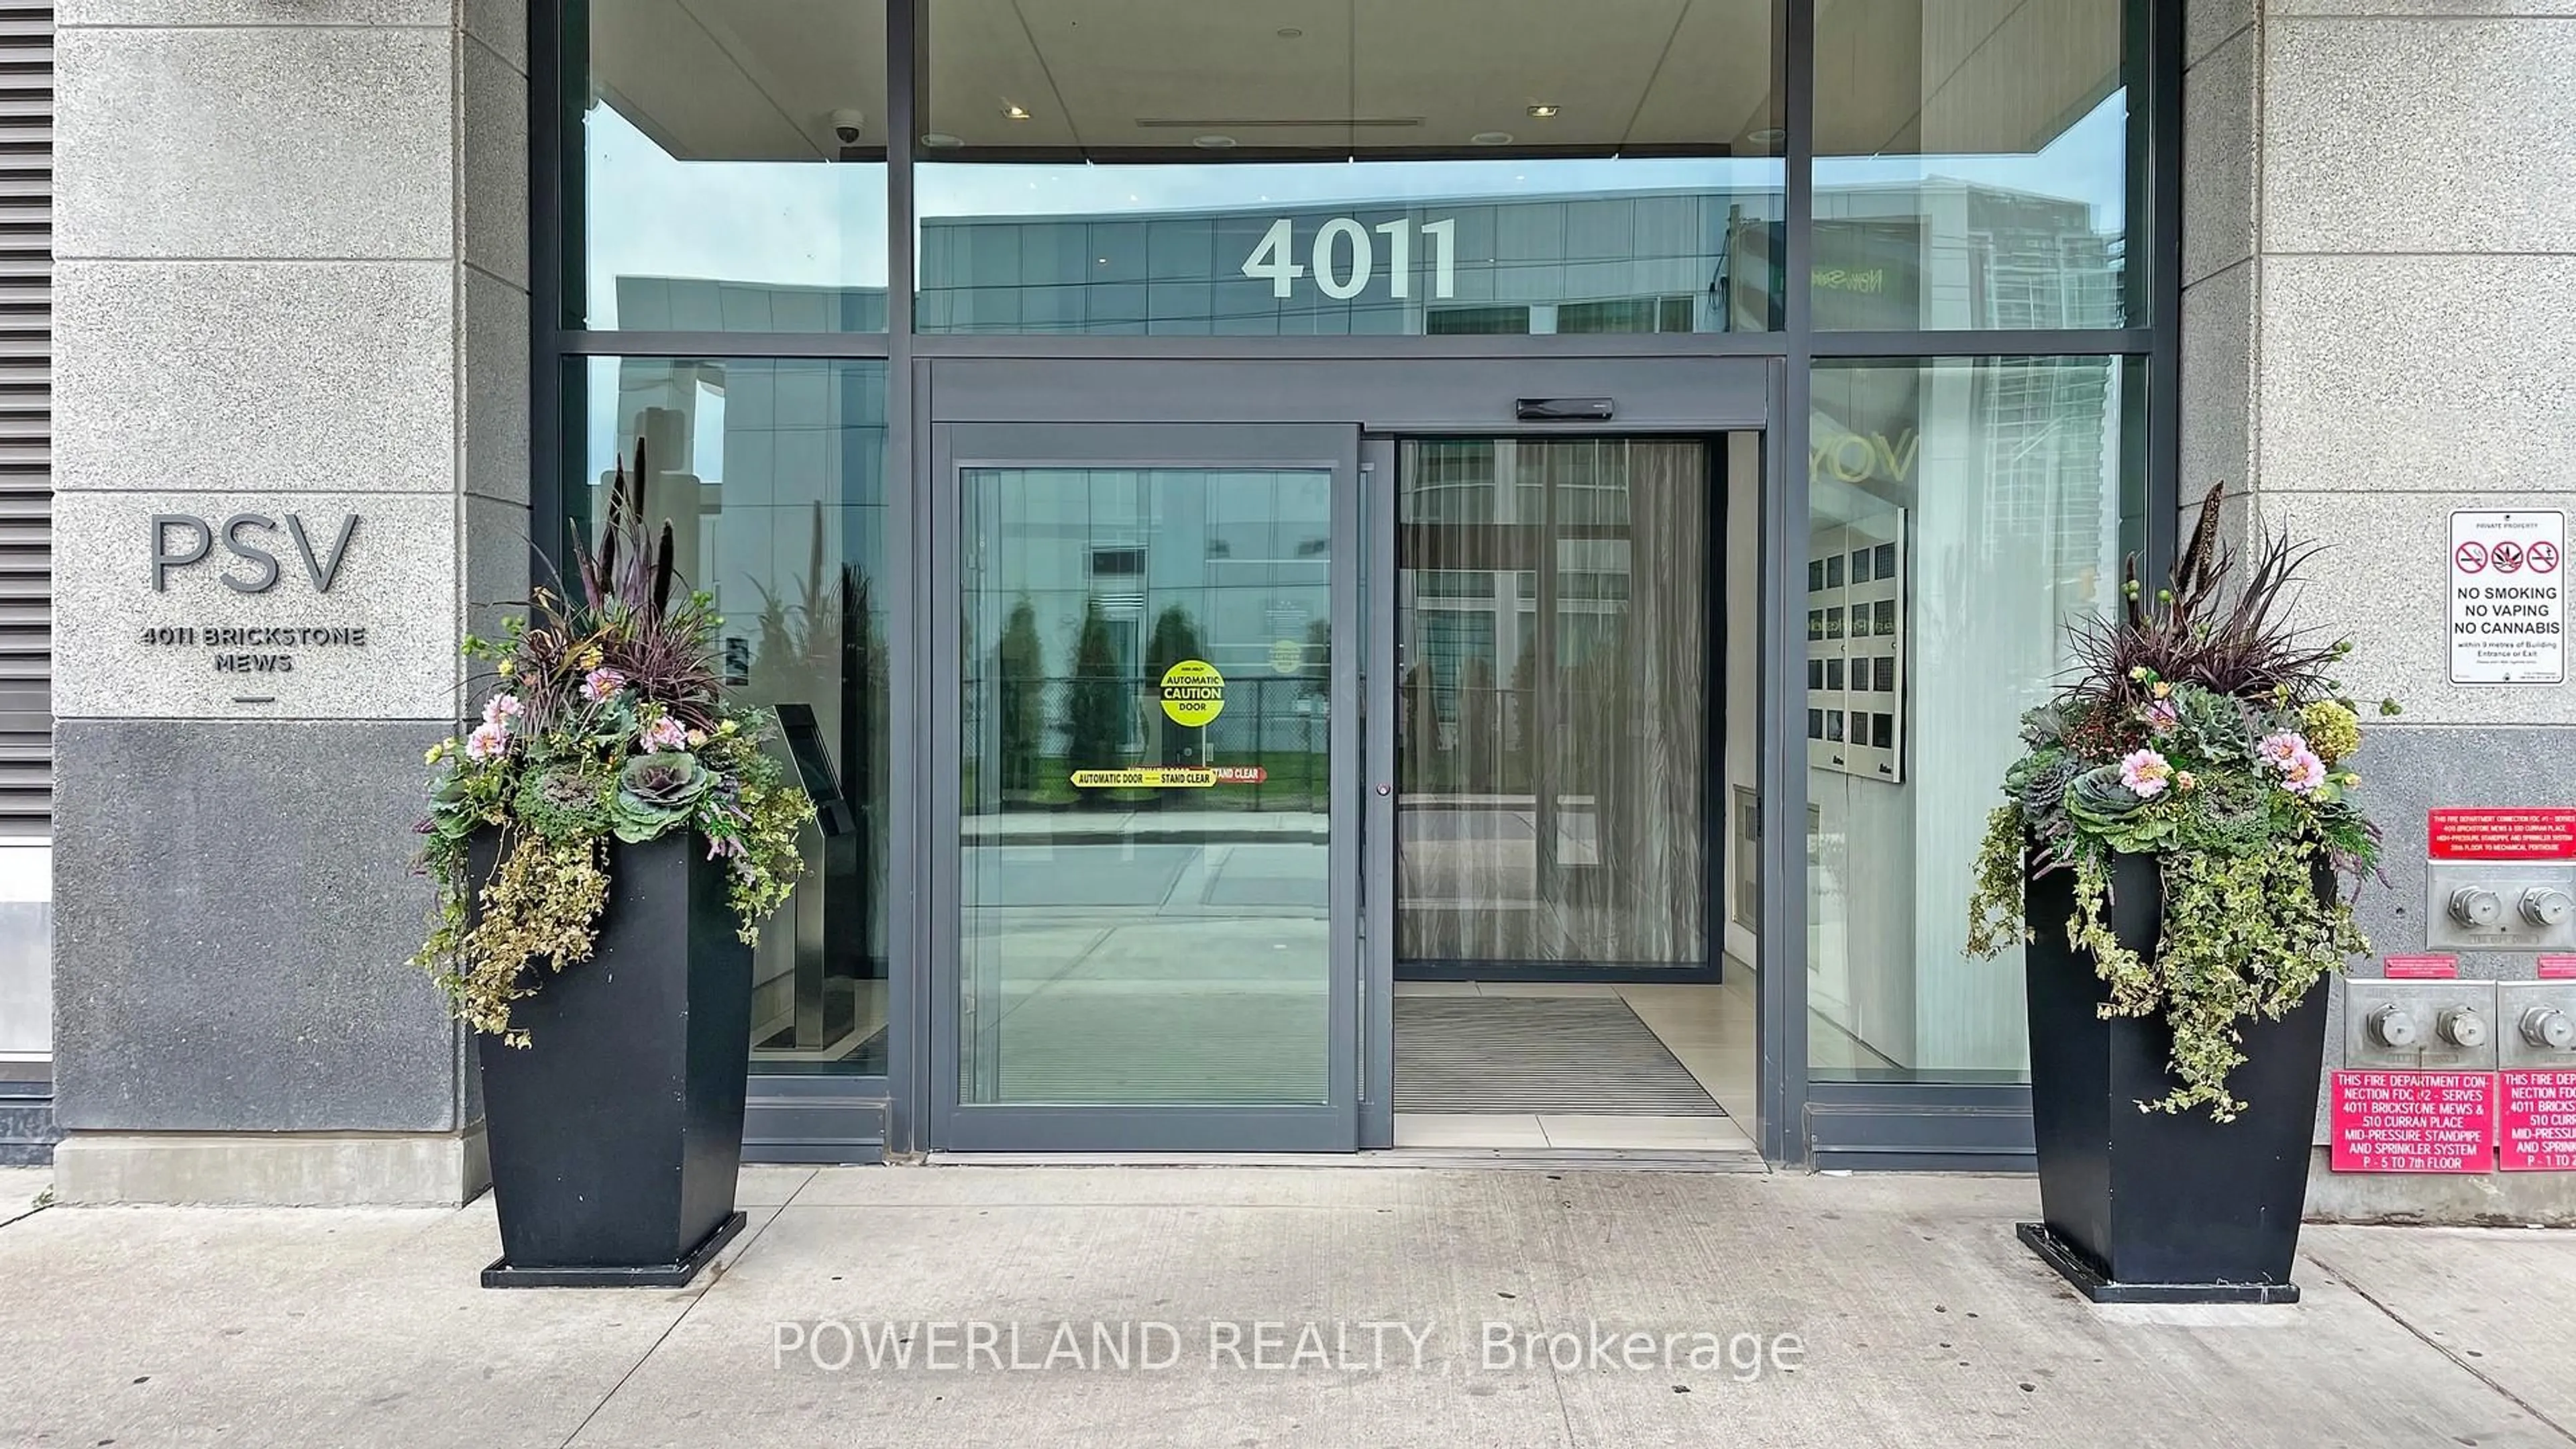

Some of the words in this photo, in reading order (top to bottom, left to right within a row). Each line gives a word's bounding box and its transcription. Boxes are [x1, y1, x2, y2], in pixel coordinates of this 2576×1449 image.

[1241, 217, 1454, 299] 4011
[152, 514, 359, 593] PSV
[2458, 588, 2480, 599] NO
[2485, 588, 2557, 599] SMOKING
[2465, 605, 2487, 616] NO
[2493, 605, 2548, 616] VAPING
[2455, 623, 2476, 633] NO
[2481, 623, 2560, 633] CANNABIS
[142, 628, 194, 646] 4011
[204, 628, 366, 646] BRICKSTONE
[215, 655, 292, 672] MEWS
[1167, 676, 1220, 684] AUTOMATIC
[1164, 688, 1221, 699] CAUTION
[1179, 703, 1206, 711] DOOR
[1079, 773, 1121, 784] AUTOMATIC
[1123, 773, 1143, 784] DOOR
[1161, 773, 1184, 784] STAND
[1187, 773, 1210, 784] CLEAR
[1213, 767, 1233, 778] TAND
[1234, 768, 1258, 779] CLEAR
[2338, 1074, 2361, 1086] THIS
[2364, 1075, 2386, 1086] FIRE
[2390, 1075, 2460, 1087] DEPARTMENT
[2505, 1073, 2528, 1085] THIS
[2531, 1073, 2553, 1085] FIRE
[2345, 1087, 2389, 1100] NECTION
[2393, 1088, 2414, 1100] FDC
[2442, 1089, 2483, 1101] SERVES
[2512, 1087, 2556, 1099] NECTION
[2343, 1102, 2367, 1113] 4011
[2371, 1102, 2436, 1114] BRICKSTONE
[2439, 1103, 2473, 1114] MEWS
[2476, 1104, 2484, 1115] &
[2510, 1101, 2534, 1112] 4011
[2362, 1116, 2381, 1127] 510
[2385, 1116, 2427, 1127] CURRAN
[2430, 1116, 2464, 1128] PLACE
[2530, 1115, 2548, 1126] 510
[2345, 1128, 2422, 1141] MID-PRESSURE
[2425, 1130, 2482, 1142] STANDPIPE
[2349, 1142, 2372, 1154] AND
[2375, 1142, 2432, 1155] SPRINKLER
[2434, 1143, 2477, 1155] SYSTEM
[2516, 1141, 2539, 1153] AND
[2381, 1156, 2388, 1168] 5
[2392, 1156, 2406, 1168] TO
[2409, 1157, 2425, 1169] 7th
[2427, 1158, 2463, 1169] FLOOR
[2546, 1155, 2551, 1166] 1
[2555, 1155, 2570, 1166] TO
